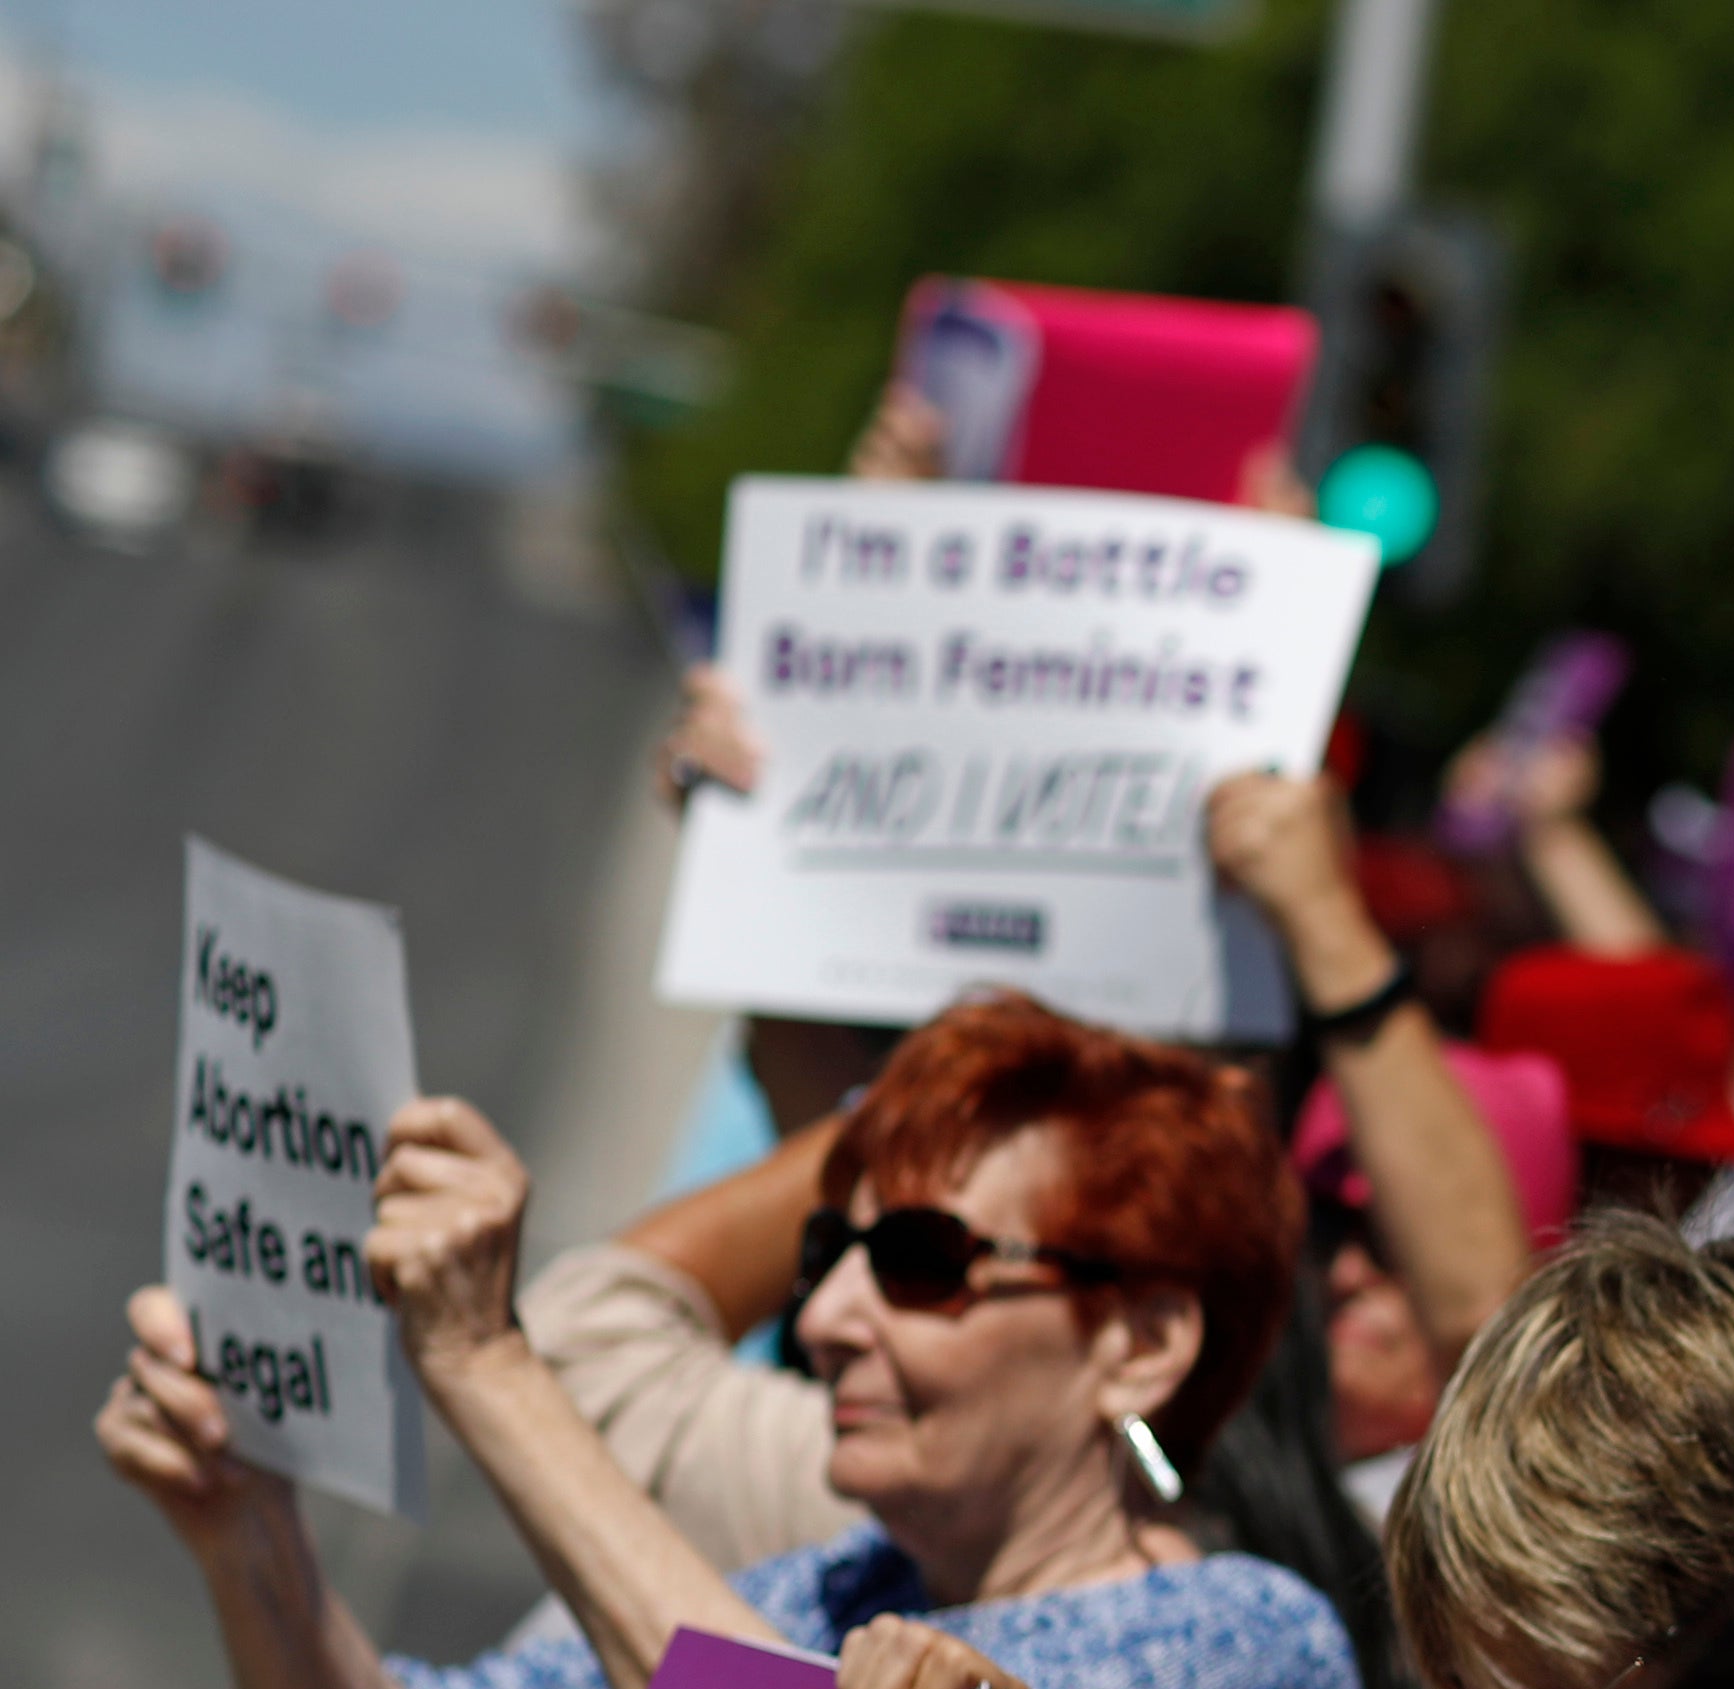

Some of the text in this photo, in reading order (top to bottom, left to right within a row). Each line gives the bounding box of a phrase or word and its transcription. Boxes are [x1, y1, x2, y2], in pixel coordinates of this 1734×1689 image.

[800, 512, 1252, 602] I'm a Battle
[763, 622, 1264, 726] Born Feminist
[195, 928, 278, 1051] Keep
[187, 1053, 380, 1184] Abortion
[181, 1184, 386, 1304] Safe an
[191, 1306, 332, 1426] Legal
